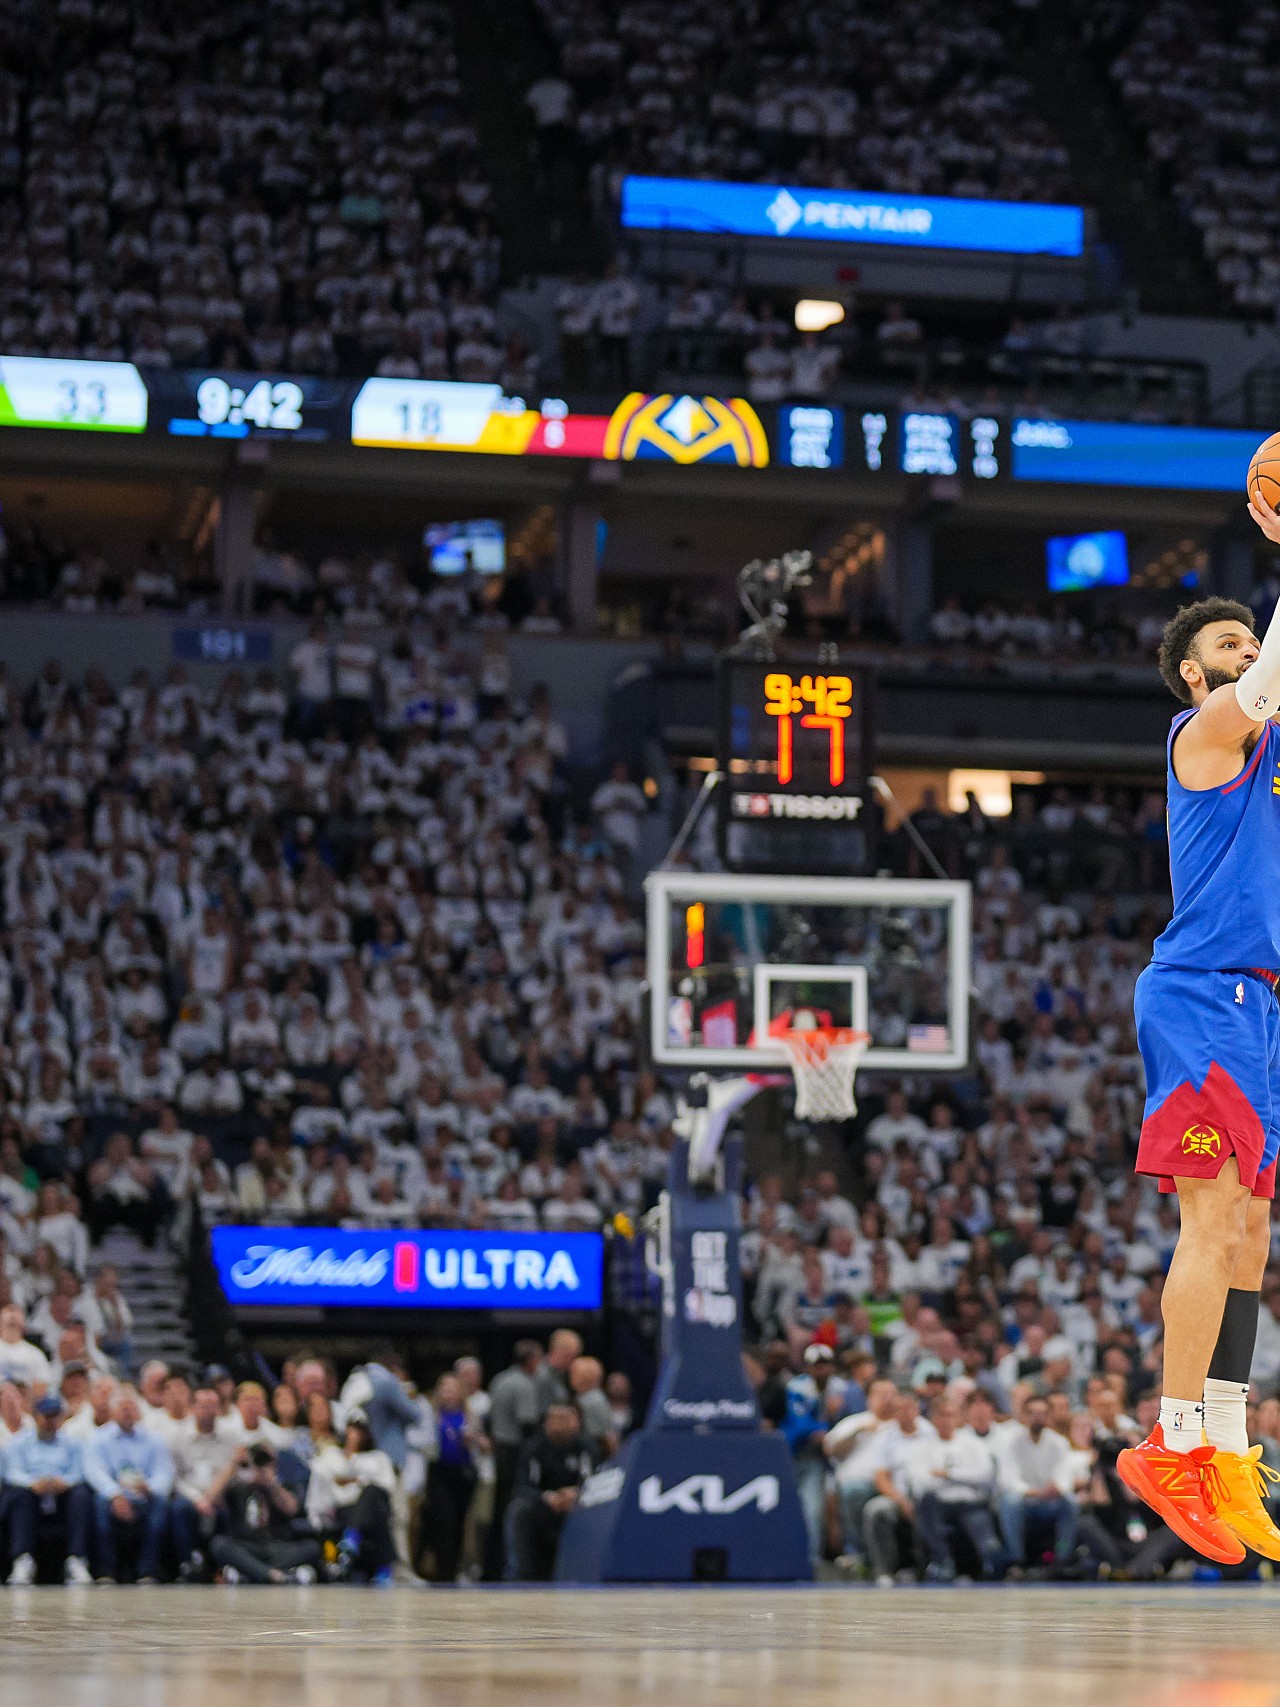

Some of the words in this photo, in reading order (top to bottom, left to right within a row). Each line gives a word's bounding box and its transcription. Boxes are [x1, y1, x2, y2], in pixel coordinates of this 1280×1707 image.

[804, 201, 932, 234] PENTAIR
[197, 377, 303, 430] 9:42
[398, 400, 442, 441] 18
[765, 674, 852, 717] 9:42
[778, 714, 844, 786] 17
[769, 794, 862, 820] TISSOT
[425, 1248, 579, 1290] ULTRA
[638, 1475, 780, 1515] KIA
